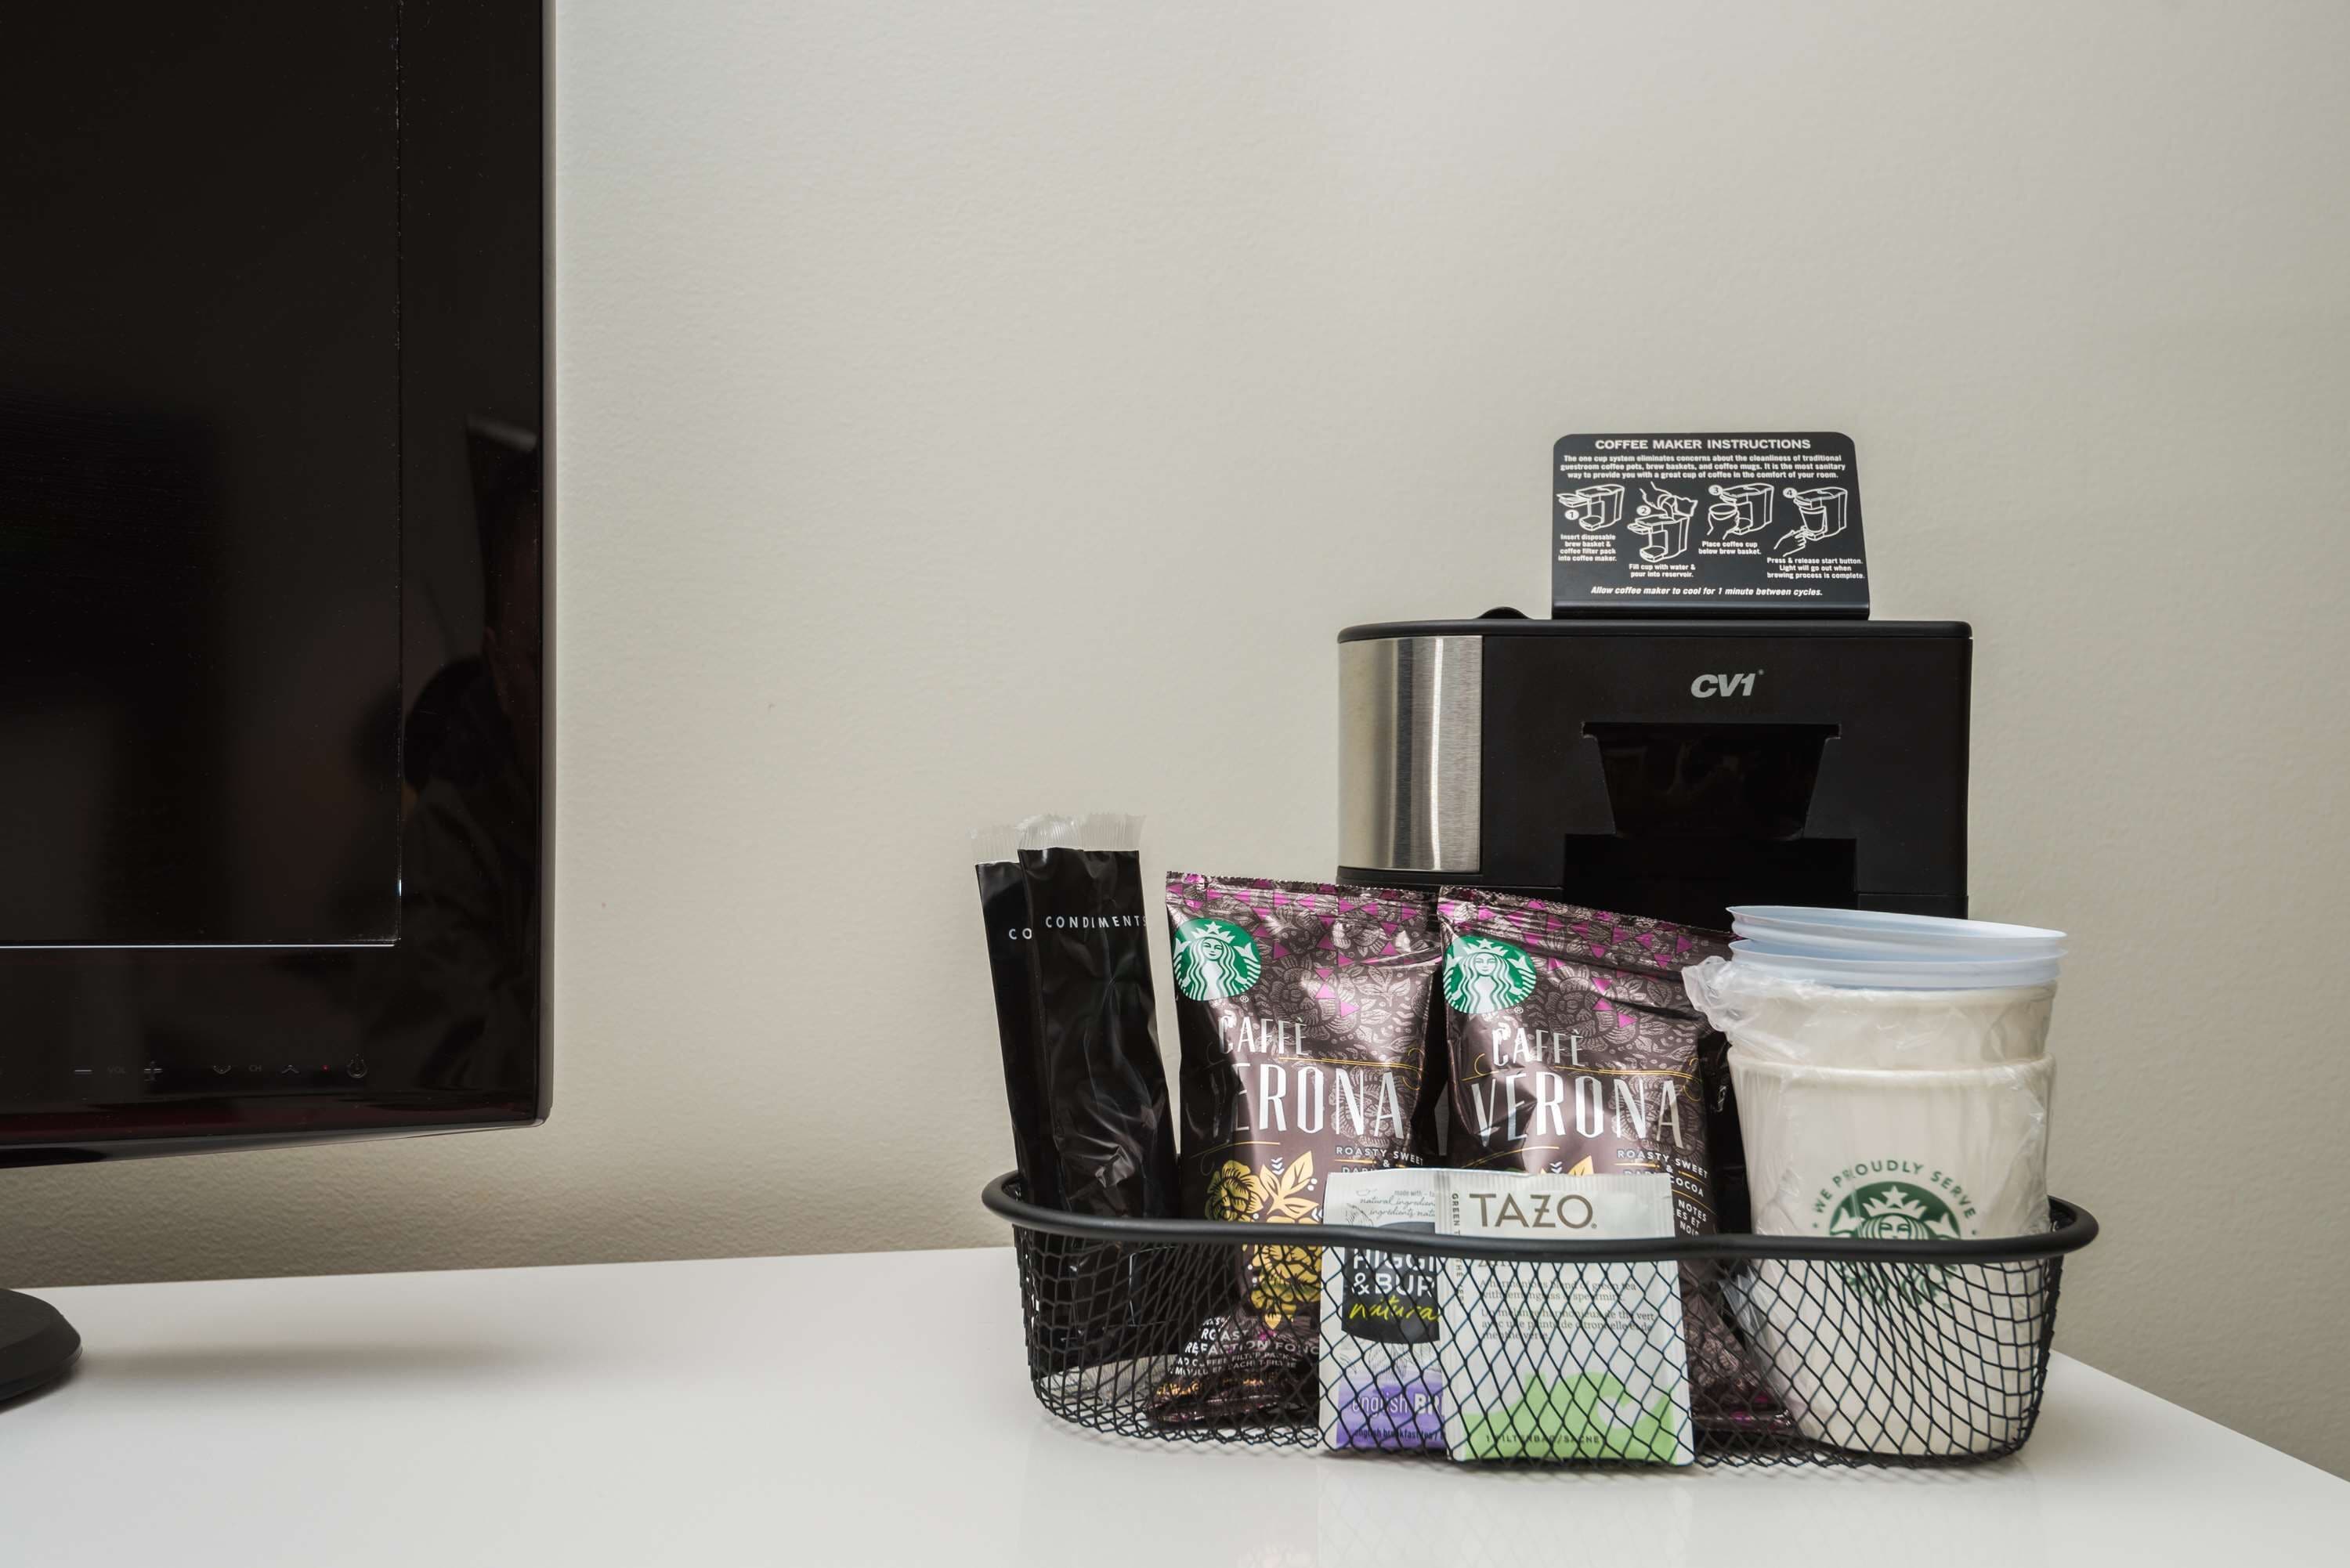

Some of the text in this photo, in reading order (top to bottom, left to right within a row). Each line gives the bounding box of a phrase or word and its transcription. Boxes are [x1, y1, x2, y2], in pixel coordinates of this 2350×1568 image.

[1595, 439, 1811, 449] COFFEE MAKER INSTRUCTIONS
[1703, 587, 1716, 596] for
[1718, 587, 1722, 596] 1
[1725, 587, 1756, 596] minute
[1758, 587, 1791, 596] between
[1793, 587, 1823, 596] cycles.
[1690, 673, 1756, 698] CV1
[1219, 1016, 1309, 1056] CAFFÈ
[1491, 1024, 1585, 1067] CAFFÈ
[1211, 1063, 1404, 1139] ERONA
[1471, 1070, 1684, 1149] VERONA
[1336, 1146, 1423, 1165] ROASTY SWEET
[1383, 1159, 1390, 1168] &
[1617, 1150, 1708, 1178] ROASTY SWEET
[1666, 1165, 1673, 1173] &
[1813, 1159, 1976, 1219] WE PROUDLY SERVE
[1452, 1193, 1460, 1226] GREEN
[1470, 1193, 1593, 1229] TAZO
[1678, 1199, 1707, 1222] NOTES
[1690, 1216, 1701, 1228] ET
[1561, 1319, 1573, 1329] de
